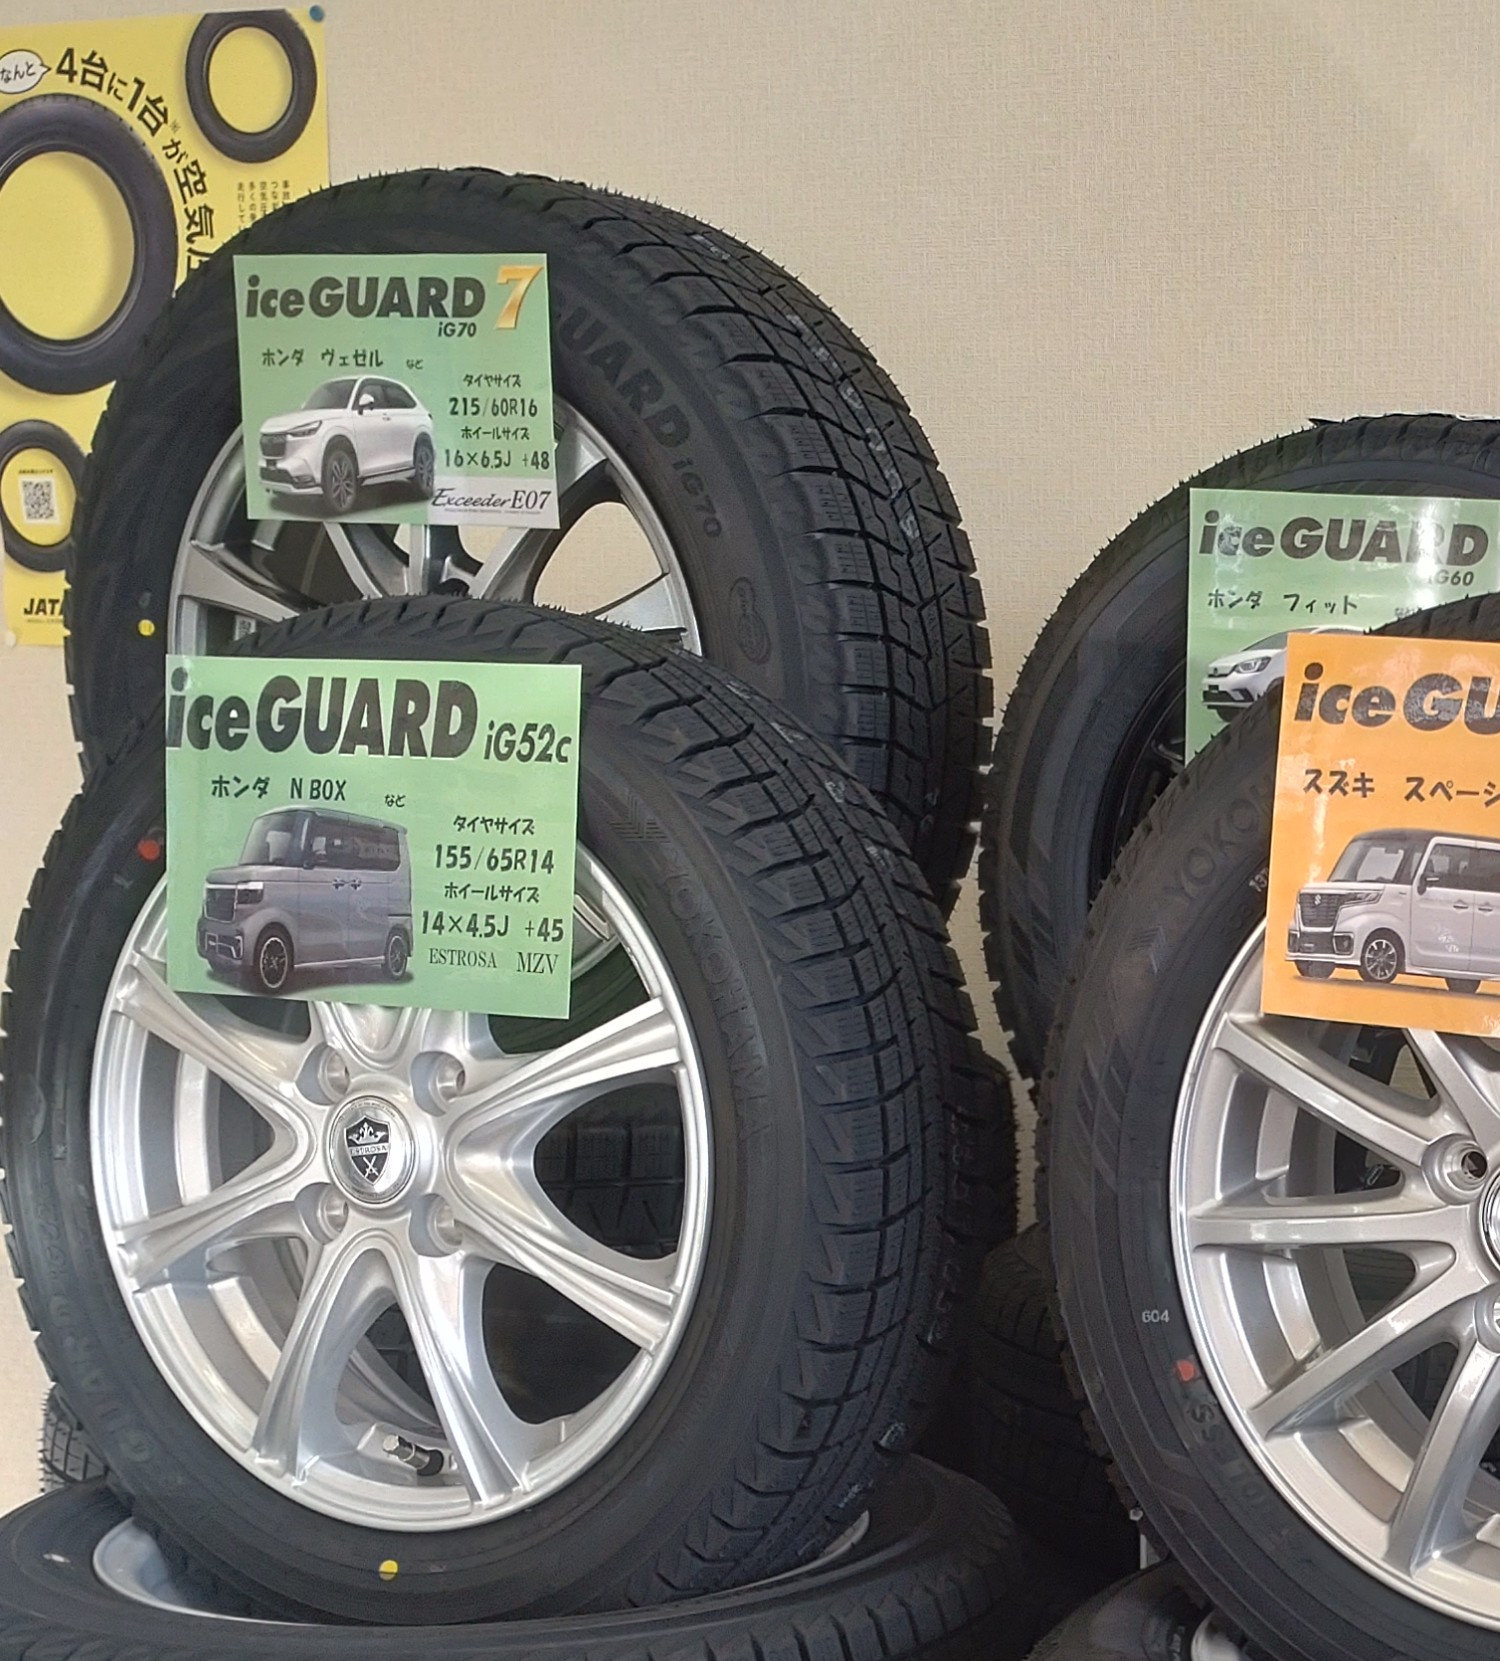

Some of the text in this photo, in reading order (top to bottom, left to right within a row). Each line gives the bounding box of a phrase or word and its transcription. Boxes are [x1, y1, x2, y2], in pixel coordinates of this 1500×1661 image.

[246, 265, 544, 330] iceGUARD 7
[438, 322, 477, 338] iG70
[261, 348, 304, 367] ホンダ
[320, 348, 384, 368] ヴェゼル
[463, 374, 522, 388] タイヤサイズ
[449, 397, 538, 417] 215/60R16
[461, 426, 530, 441] ホイールサイズ
[522, 451, 551, 470] +48
[24, 598, 64, 616] JAT
[1207, 590, 1358, 615] ホンダ フィット
[167, 667, 479, 759] iceGUARD
[211, 775, 270, 799] ホンダ
[1301, 768, 1376, 798] スズキ
[453, 815, 536, 836] タイヤサイズ
[435, 843, 555, 875] 155/65R14
[444, 881, 540, 904] ホイールサイズ
[524, 917, 564, 943] +45
[428, 948, 560, 975] ESTROSA MZV
